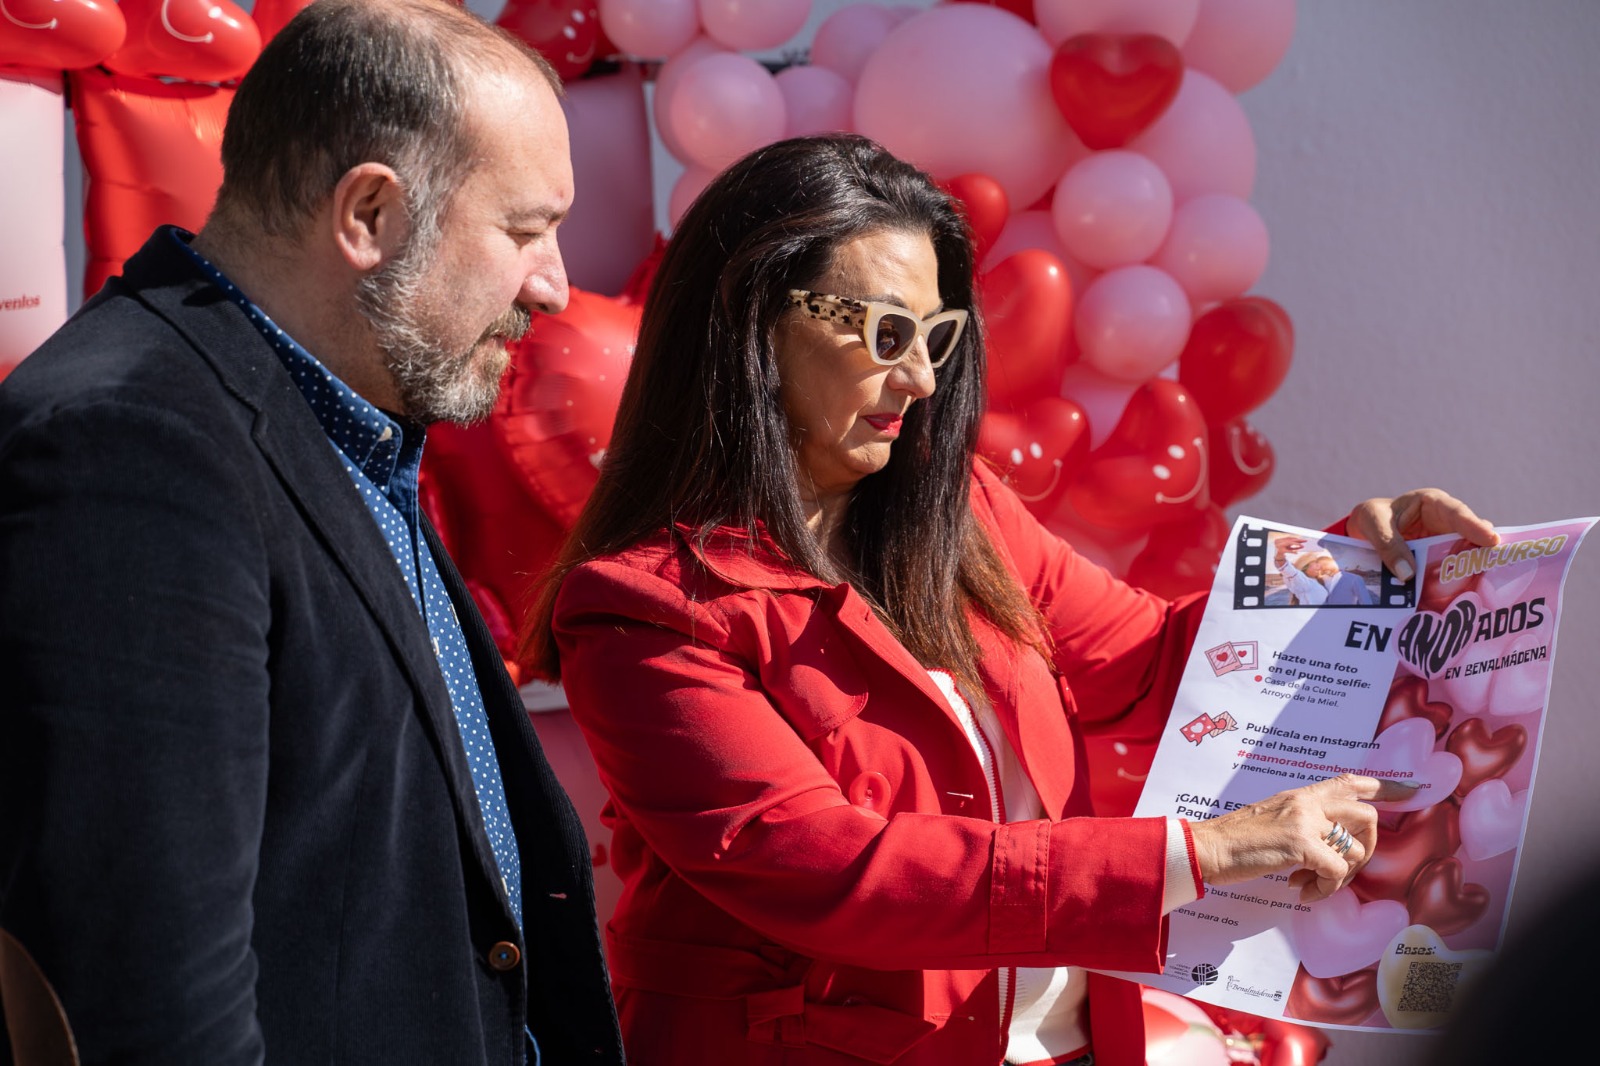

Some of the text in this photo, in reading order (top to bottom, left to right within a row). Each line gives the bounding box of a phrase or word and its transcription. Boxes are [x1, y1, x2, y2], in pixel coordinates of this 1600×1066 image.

[1440, 534, 1569, 584] CONCURSO
[1272, 651, 1358, 674] Hazte una foto
[1444, 645, 1547, 680] EN BENALMÁDENA
[1264, 676, 1347, 698] Casa de la Cultura
[1268, 665, 1371, 689] en el punto selfie:
[1260, 688, 1339, 708] Arroyo de la Miel.
[1241, 737, 1327, 758] con el hashtag
[1246, 722, 1381, 751] Publícala en Instagram
[1232, 762, 1239, 770] y
[1240, 764, 1287, 777] menciona
[1297, 772, 1306, 780] la
[1237, 749, 1414, 779] #enamoradosenbenalmadena
[1175, 793, 1221, 808] ¡GANA
[1211, 887, 1228, 897] bus
[1230, 892, 1269, 905] turístico
[1270, 900, 1292, 910] para
[1294, 903, 1312, 913] dos
[1198, 912, 1219, 922] para
[1221, 916, 1240, 926] dos
[1395, 943, 1437, 955] Bases:
